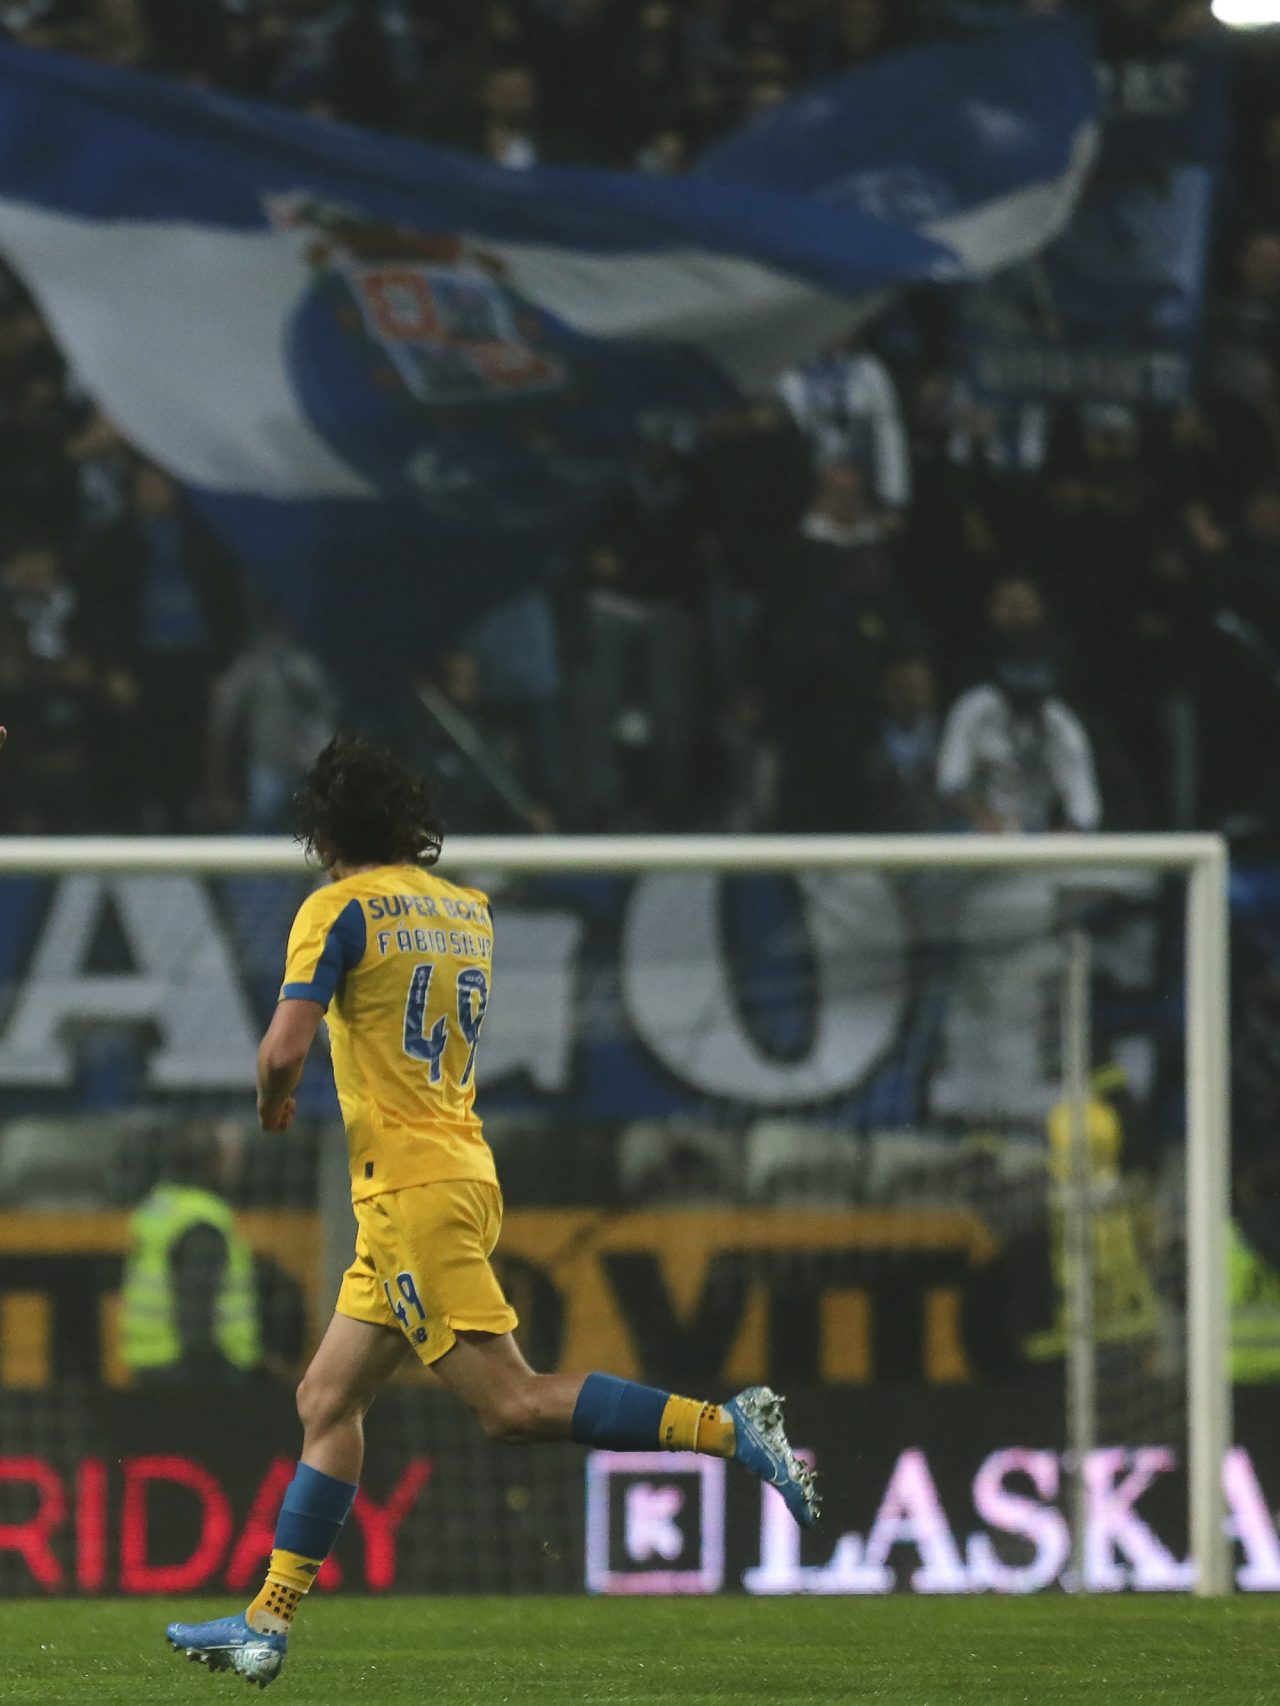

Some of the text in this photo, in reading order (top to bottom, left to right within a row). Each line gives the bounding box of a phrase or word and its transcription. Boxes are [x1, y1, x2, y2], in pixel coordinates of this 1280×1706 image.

[368, 895, 439, 920] SUPER
[377, 920, 447, 955] FÁBIO
[402, 962, 489, 1088] 49
[383, 1271, 426, 1328] 49
[625, 1481, 685, 1561] K
